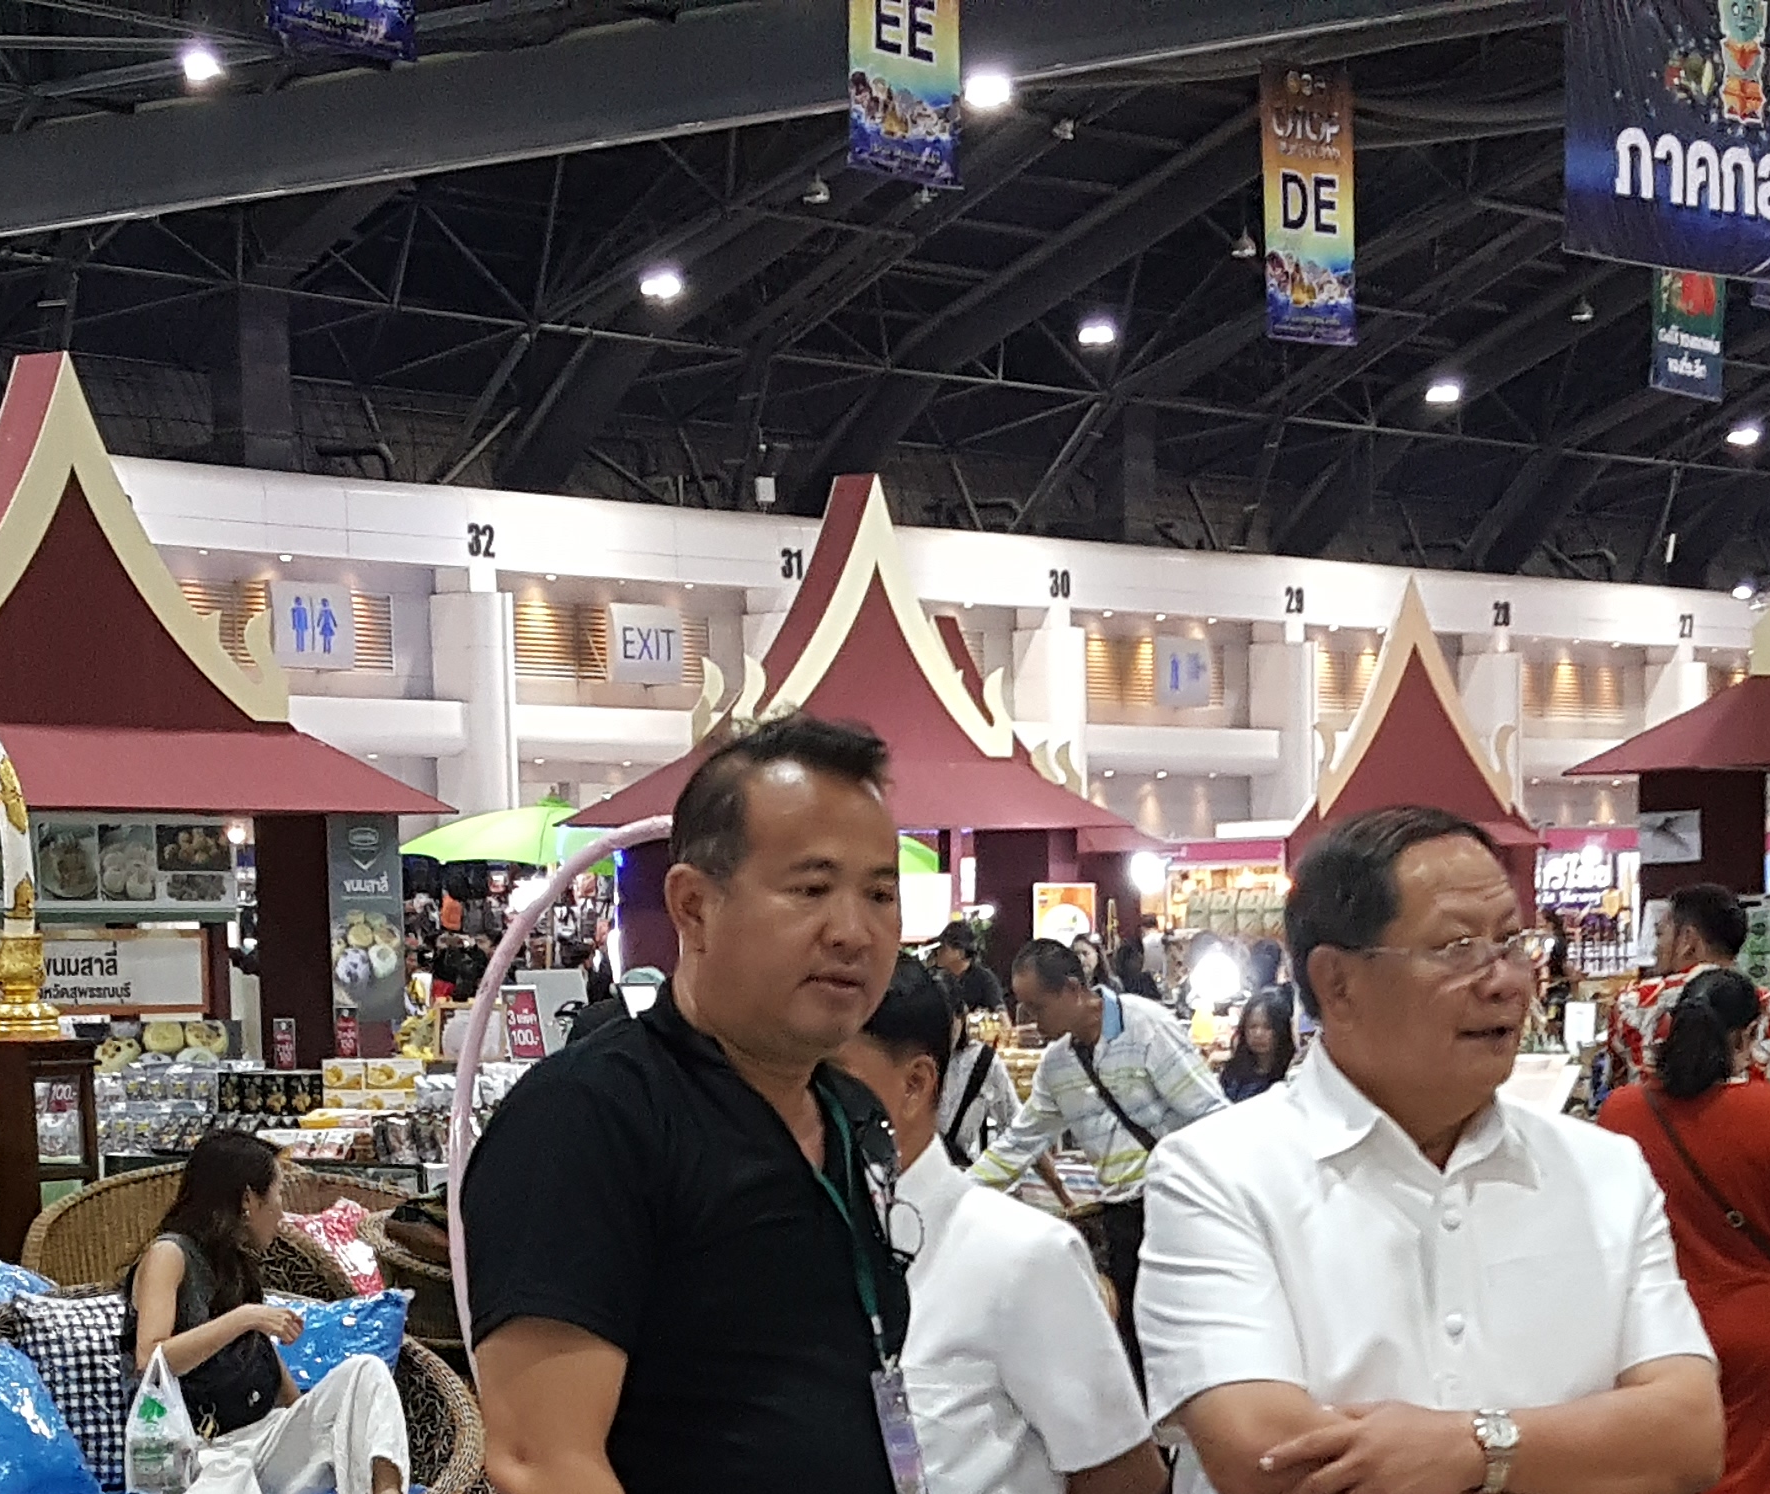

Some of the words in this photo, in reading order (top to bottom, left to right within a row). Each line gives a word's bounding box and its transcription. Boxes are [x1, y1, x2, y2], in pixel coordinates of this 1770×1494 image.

[872, 0, 938, 62] EE
[1281, 170, 1338, 236] DE
[468, 524, 495, 557] 32
[781, 548, 803, 580] 31
[1050, 570, 1070, 598] 30
[623, 628, 676, 661] EXIT
[38, 981, 131, 1005] งหวัดสุพรรณบุรี
